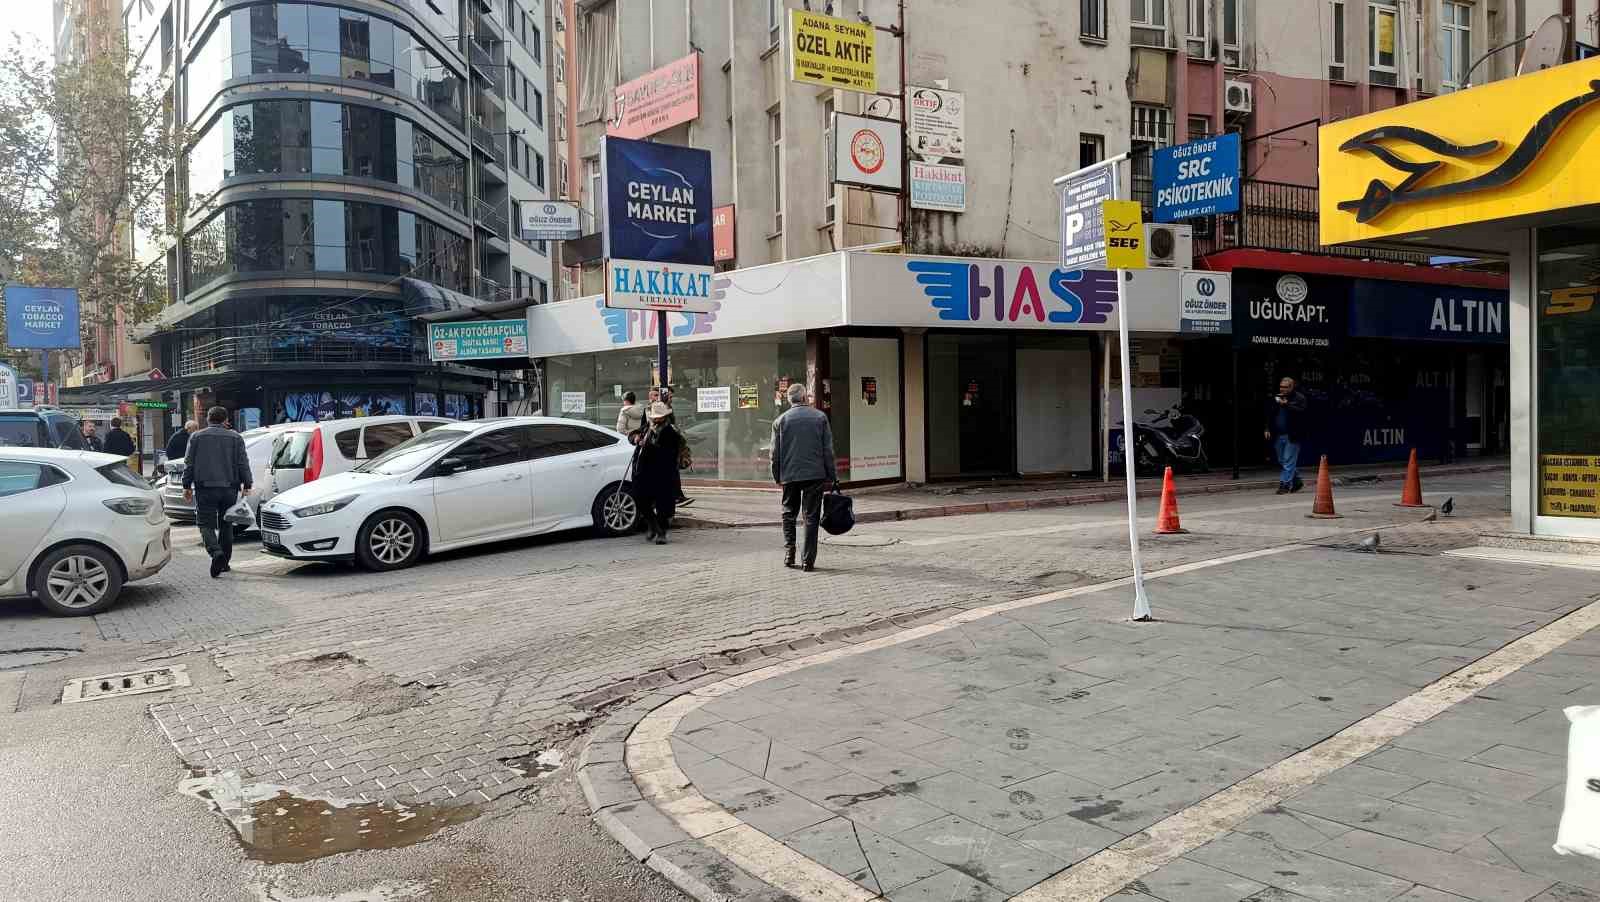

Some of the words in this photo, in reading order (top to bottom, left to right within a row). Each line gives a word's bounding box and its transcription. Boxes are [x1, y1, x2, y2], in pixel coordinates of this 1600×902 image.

[803, 17, 831, 31] ADANA
[834, 24, 866, 39] SEYHAN
[796, 28, 831, 57] ÖZEL
[834, 39, 872, 64] AKTİF
[1173, 145, 1192, 159] OĞUZ
[1192, 141, 1217, 155] ÖNDER
[914, 166, 963, 184] Hakikat
[1177, 157, 1212, 180] SRC
[628, 181, 694, 206] CEYLAN
[1157, 172, 1233, 208] PSİKOTEKNİK
[627, 201, 697, 225] MARKET
[1066, 212, 1084, 247] P
[1109, 237, 1139, 250] SEÇ
[614, 266, 711, 299] HAKİKAT
[969, 263, 1083, 323] HAS
[24, 304, 60, 314] CEYLAN
[1184, 299, 1204, 310] OĞUZ
[1203, 299, 1228, 312] ÖNDER
[1249, 297, 1294, 321] UĞUR
[1295, 305, 1329, 323] APT.
[1429, 297, 1502, 334] ALTIN
[22, 312, 64, 322] TOBACCO
[24, 320, 62, 329] MARKET
[311, 321, 352, 330] TOBACCO
[433, 326, 459, 339] ÖZ-AK
[459, 323, 526, 338] FOTOĞRAFÇILIK
[1362, 427, 1405, 446] ALTIN
